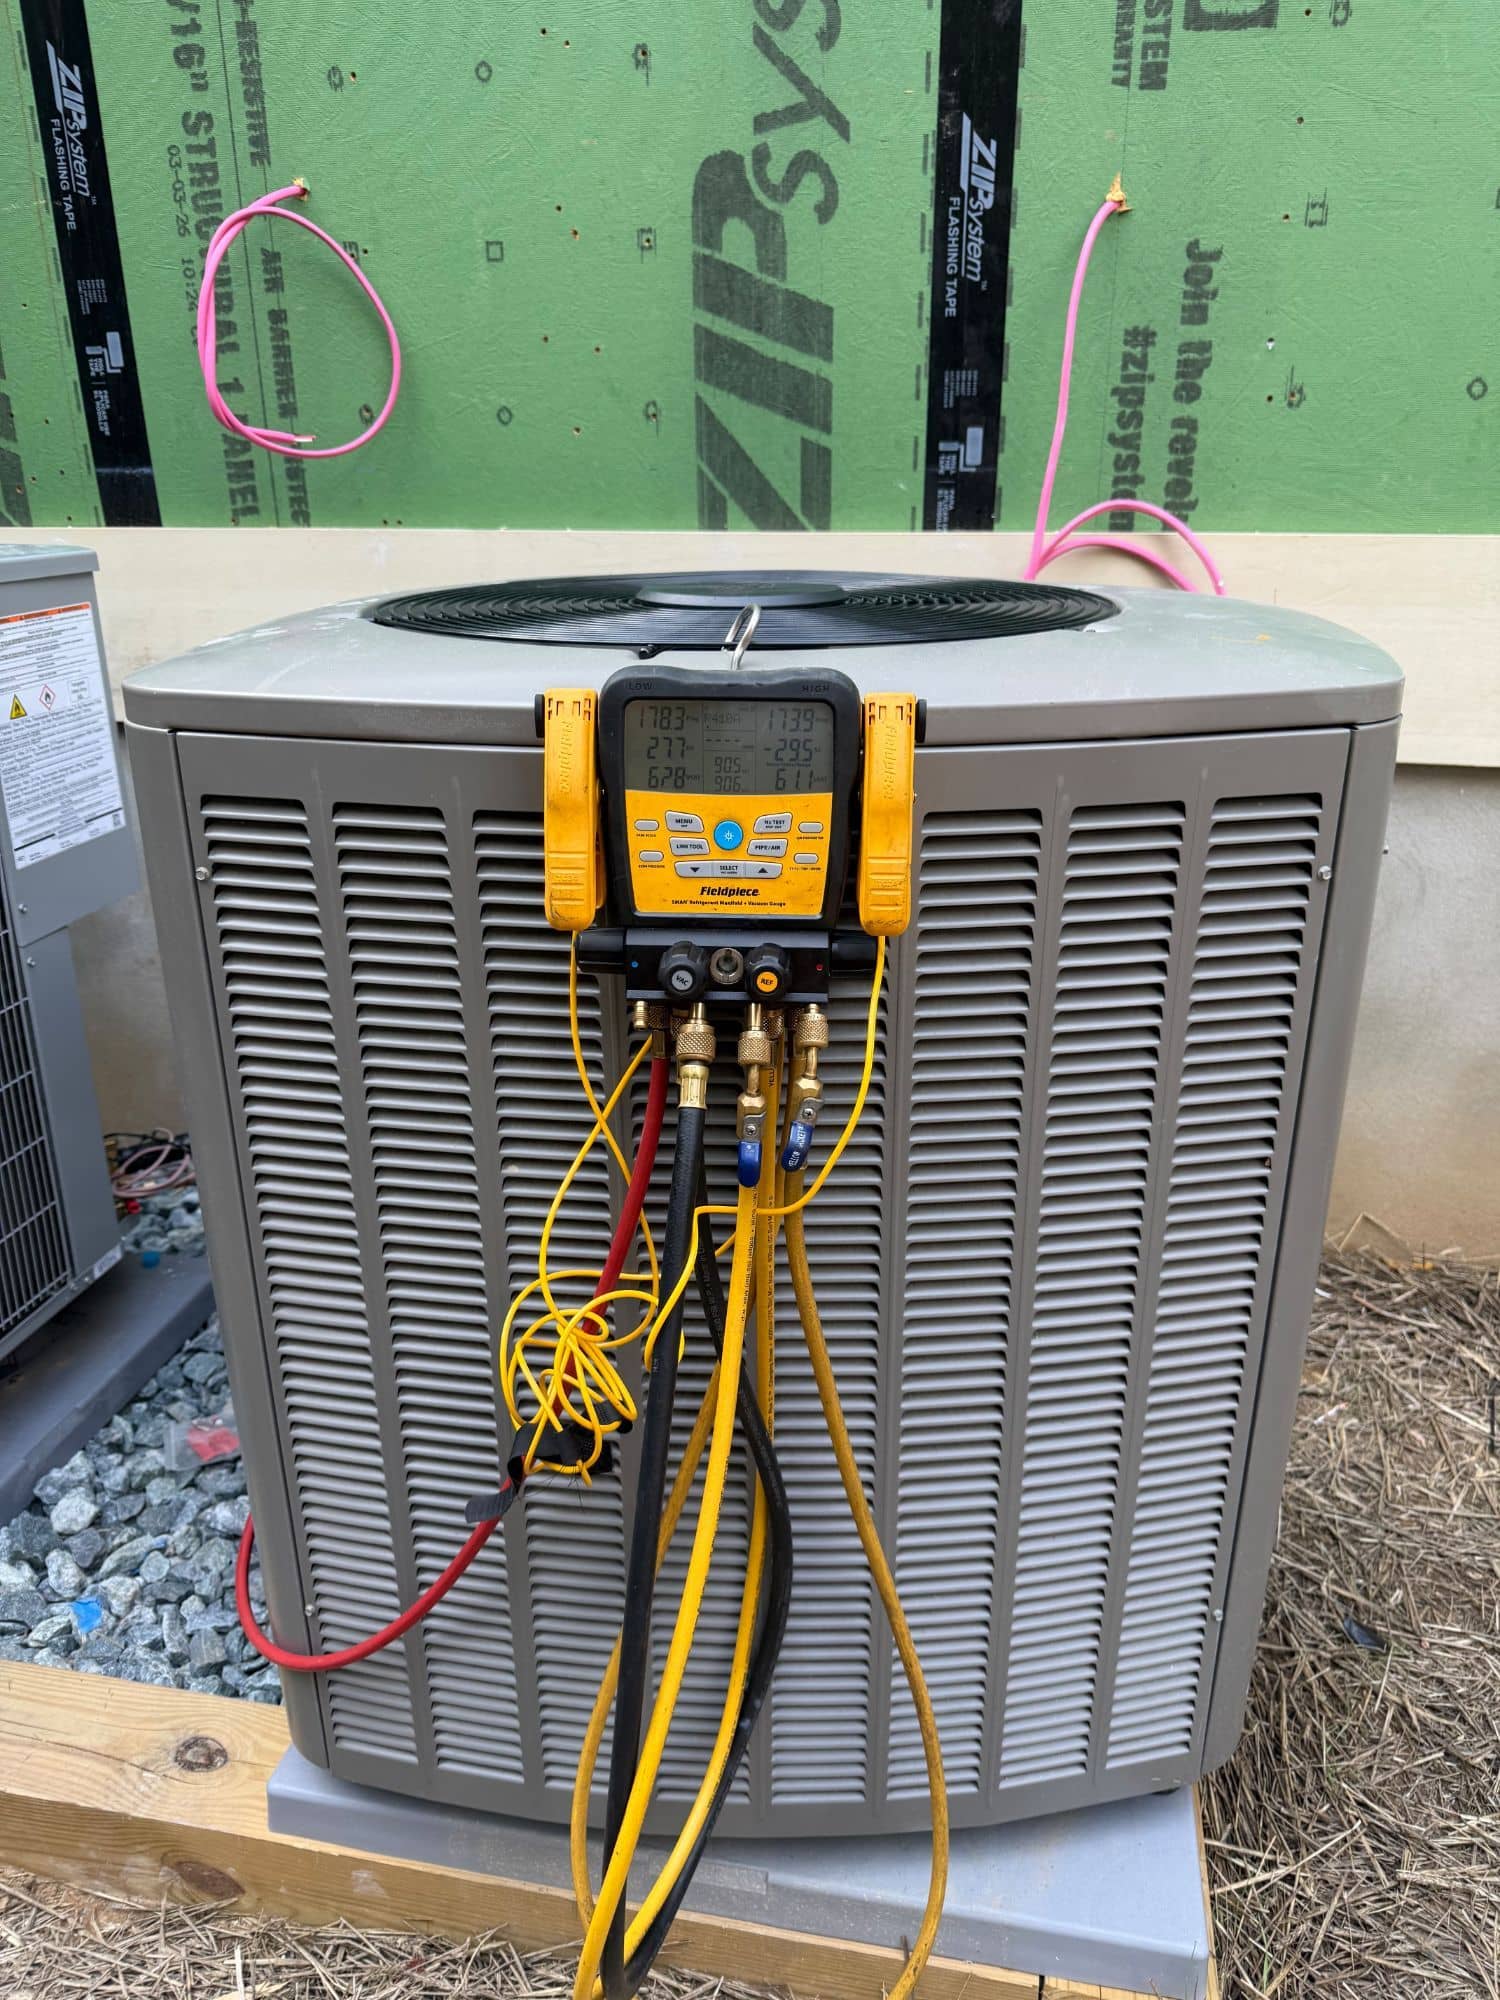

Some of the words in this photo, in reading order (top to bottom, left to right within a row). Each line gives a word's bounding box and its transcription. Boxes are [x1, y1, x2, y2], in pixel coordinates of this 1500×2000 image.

[51, 118, 70, 192] FLASHING
[62, 194, 77, 232] TAPE
[166, 144, 191, 238] 03-03-26
[946, 196, 961, 275] FLASHING
[944, 279, 958, 318] TAPE
[1180, 238, 1224, 326] Join
[1173, 340, 1213, 404] the
[221, 413, 260, 526] ANEL
[802, 682, 831, 693] HIGH
[700, 886, 760, 898] Fieldpiece
[675, 975, 689, 987] VAC
[760, 978, 774, 986] REF
